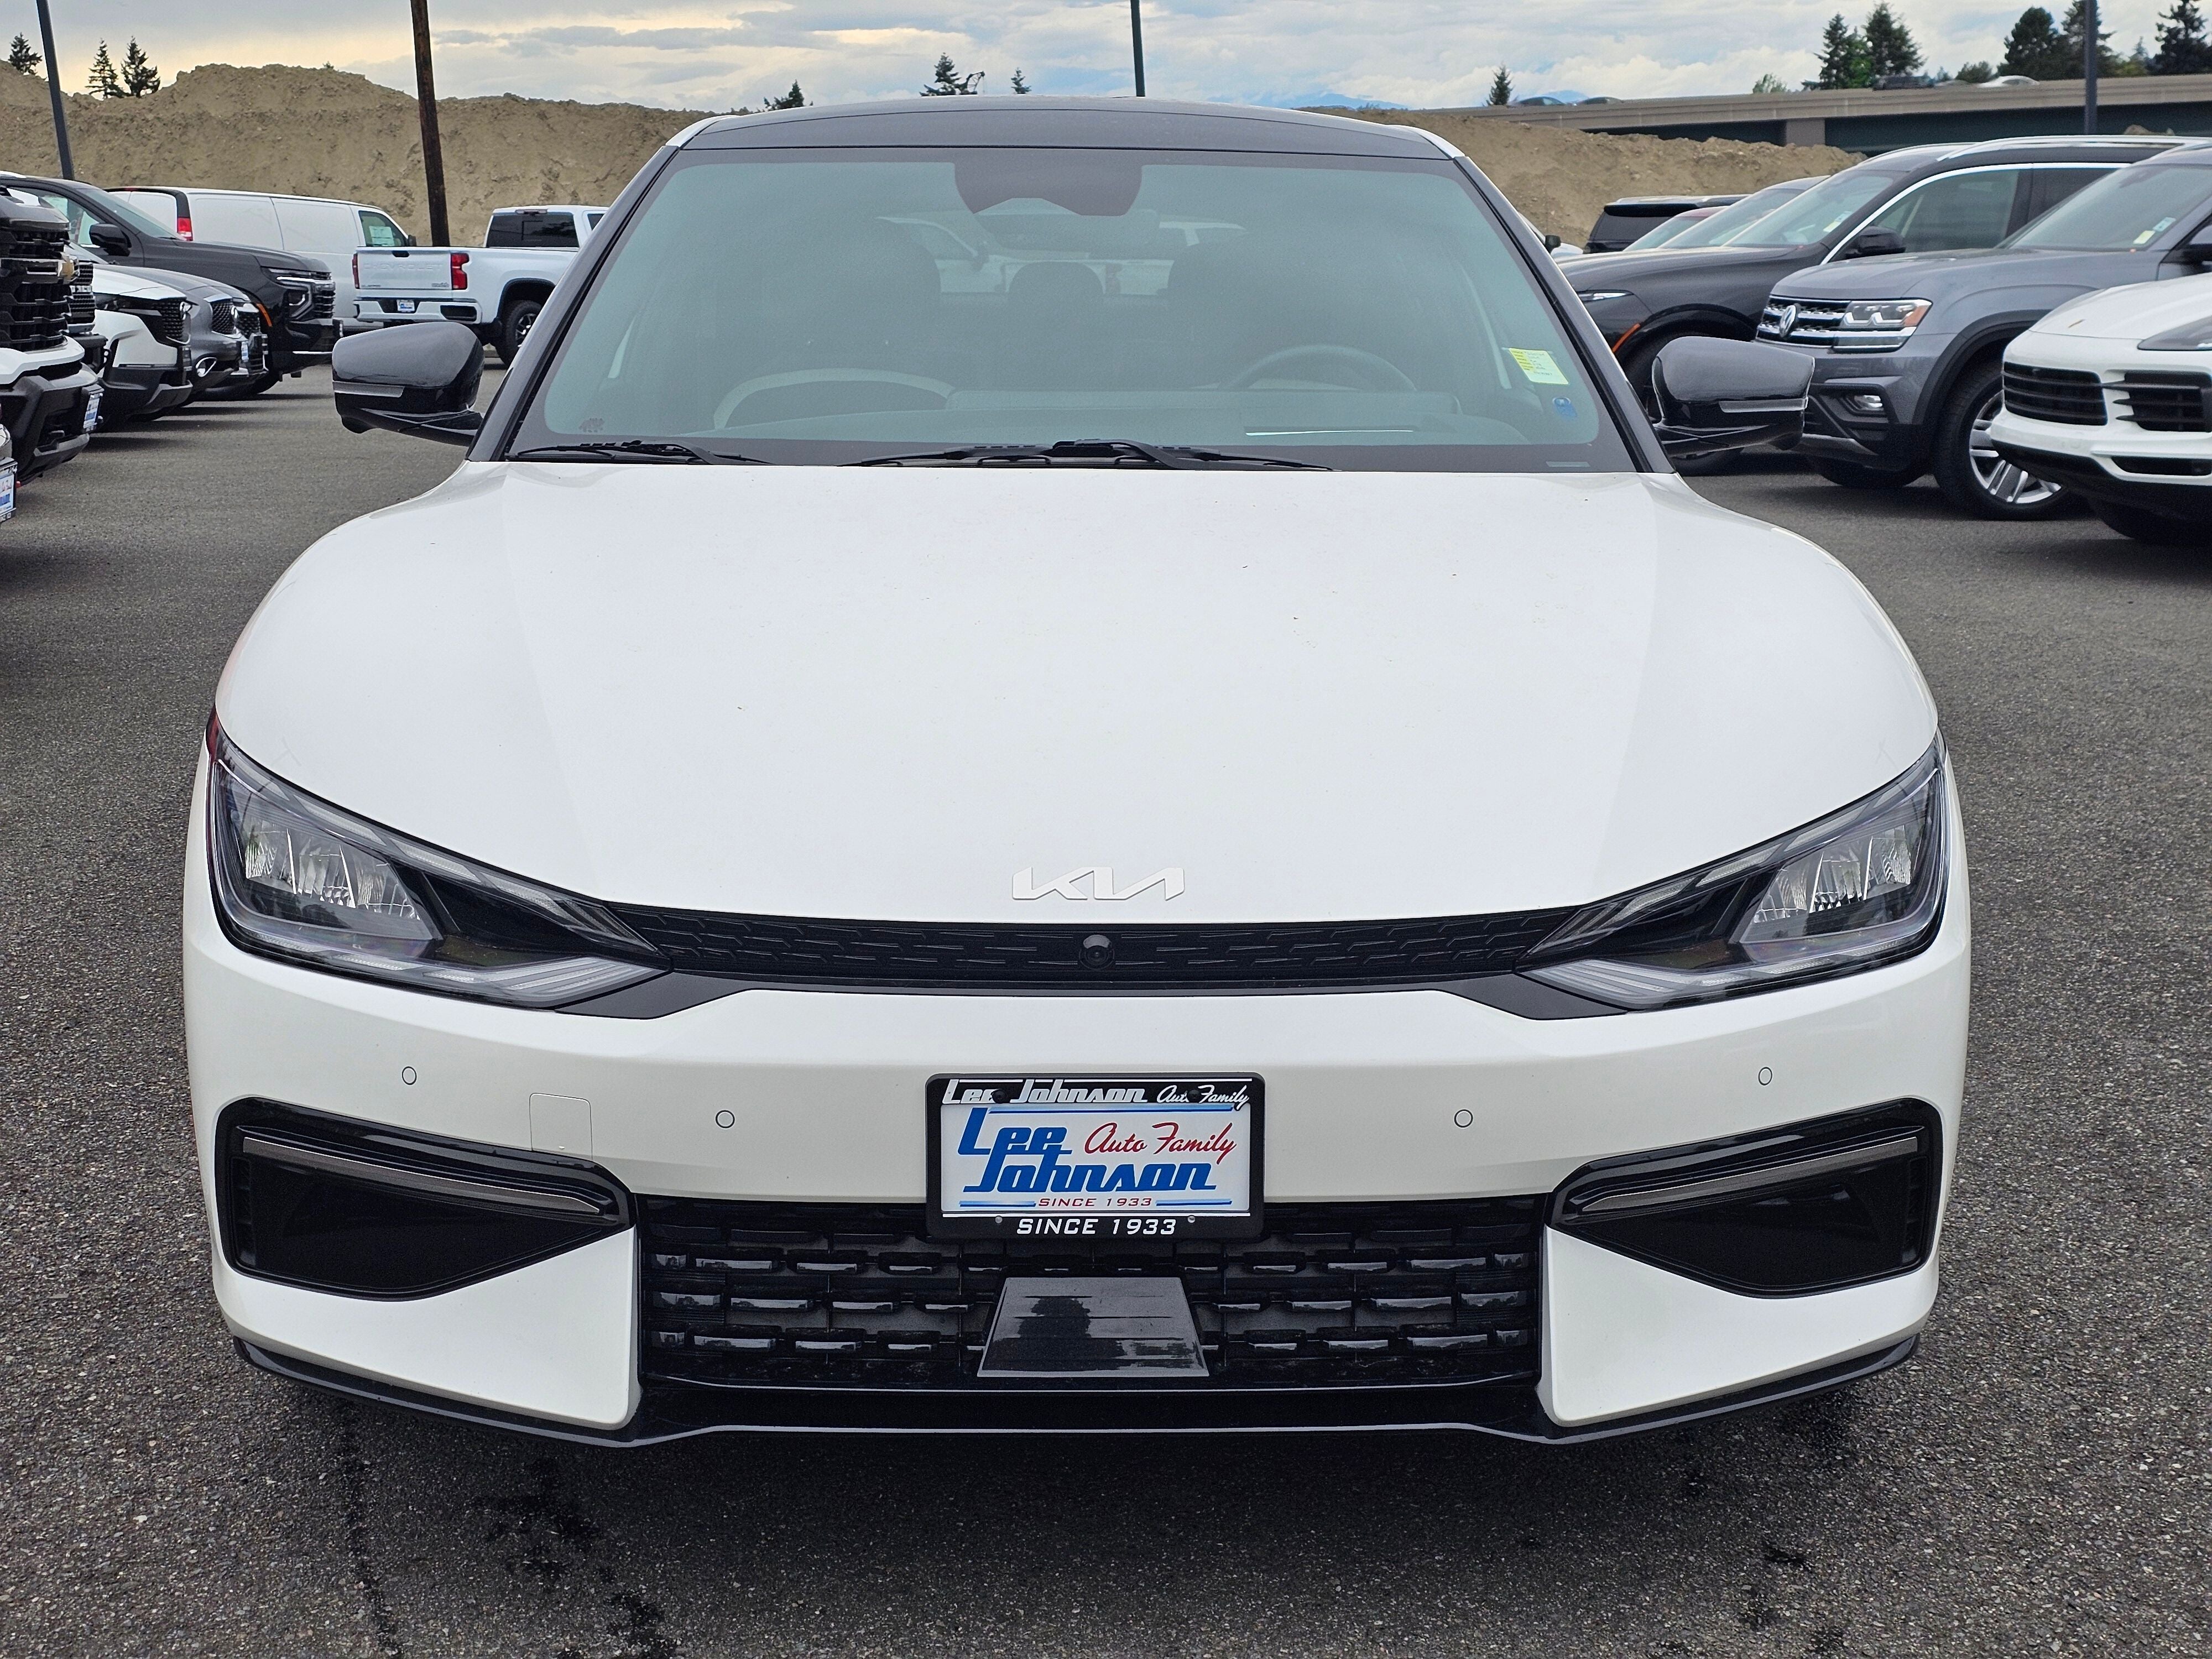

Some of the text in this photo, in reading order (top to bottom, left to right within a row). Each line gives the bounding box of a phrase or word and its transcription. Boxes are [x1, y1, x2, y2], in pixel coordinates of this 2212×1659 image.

[1010, 1079, 1148, 1103] Johnson
[1156, 1084, 1190, 1103] Aut
[1197, 1084, 1249, 1110] Family
[957, 1107, 1237, 1165] Lee Auto Family
[963, 1147, 1217, 1192] Johnson
[1038, 1198, 1152, 1207] SINCE 1933
[1016, 1218, 1176, 1235] SINCE 1933
